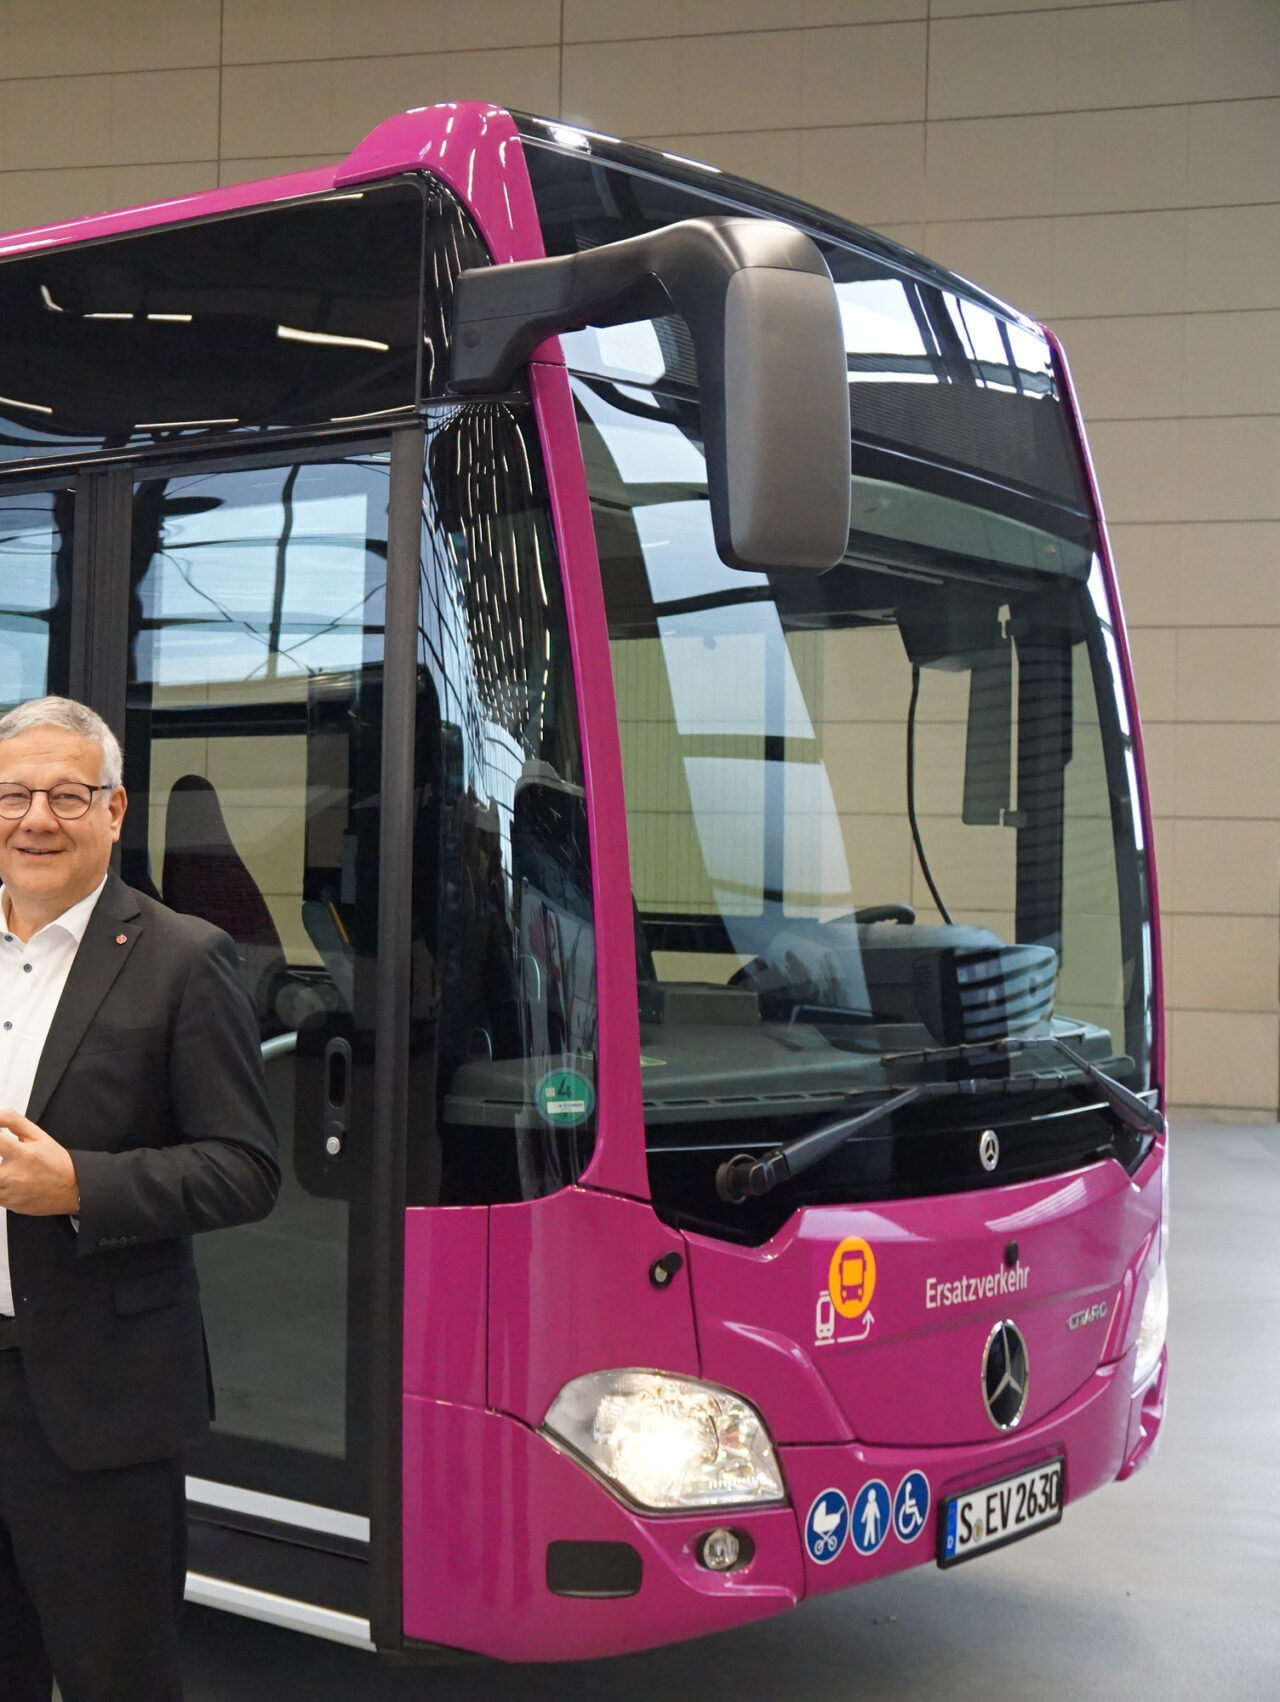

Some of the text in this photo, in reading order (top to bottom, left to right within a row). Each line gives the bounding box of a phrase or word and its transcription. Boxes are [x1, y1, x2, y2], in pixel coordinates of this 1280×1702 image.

[557, 1077, 572, 1098] 4
[925, 1260, 1030, 1309] Ersatzverkehr
[958, 1502, 973, 1545] S
[985, 1487, 1012, 1536] EV
[1015, 1469, 1060, 1525] 2630
